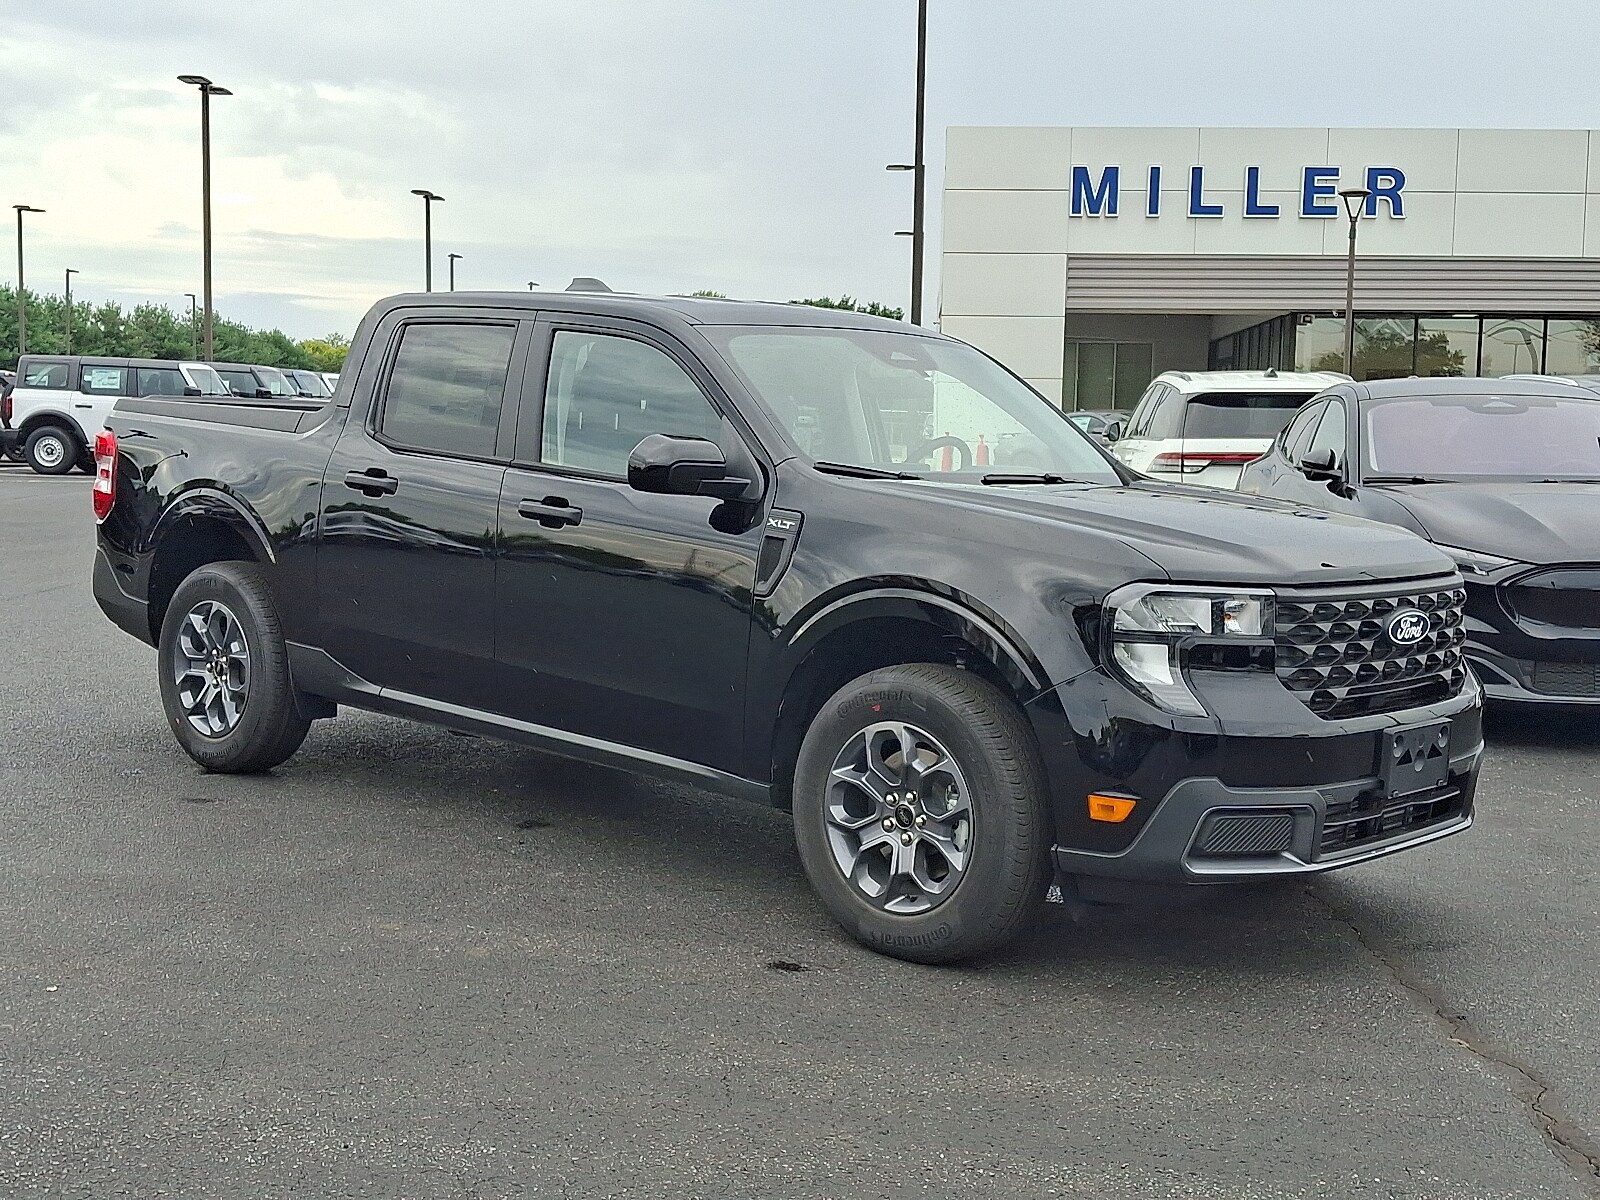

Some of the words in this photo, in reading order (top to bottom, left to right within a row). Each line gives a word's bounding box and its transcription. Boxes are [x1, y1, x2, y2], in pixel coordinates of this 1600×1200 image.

[1069, 165, 1406, 218] MILLER
[767, 517, 796, 530] XLT
[1397, 616, 1424, 640] Ford
